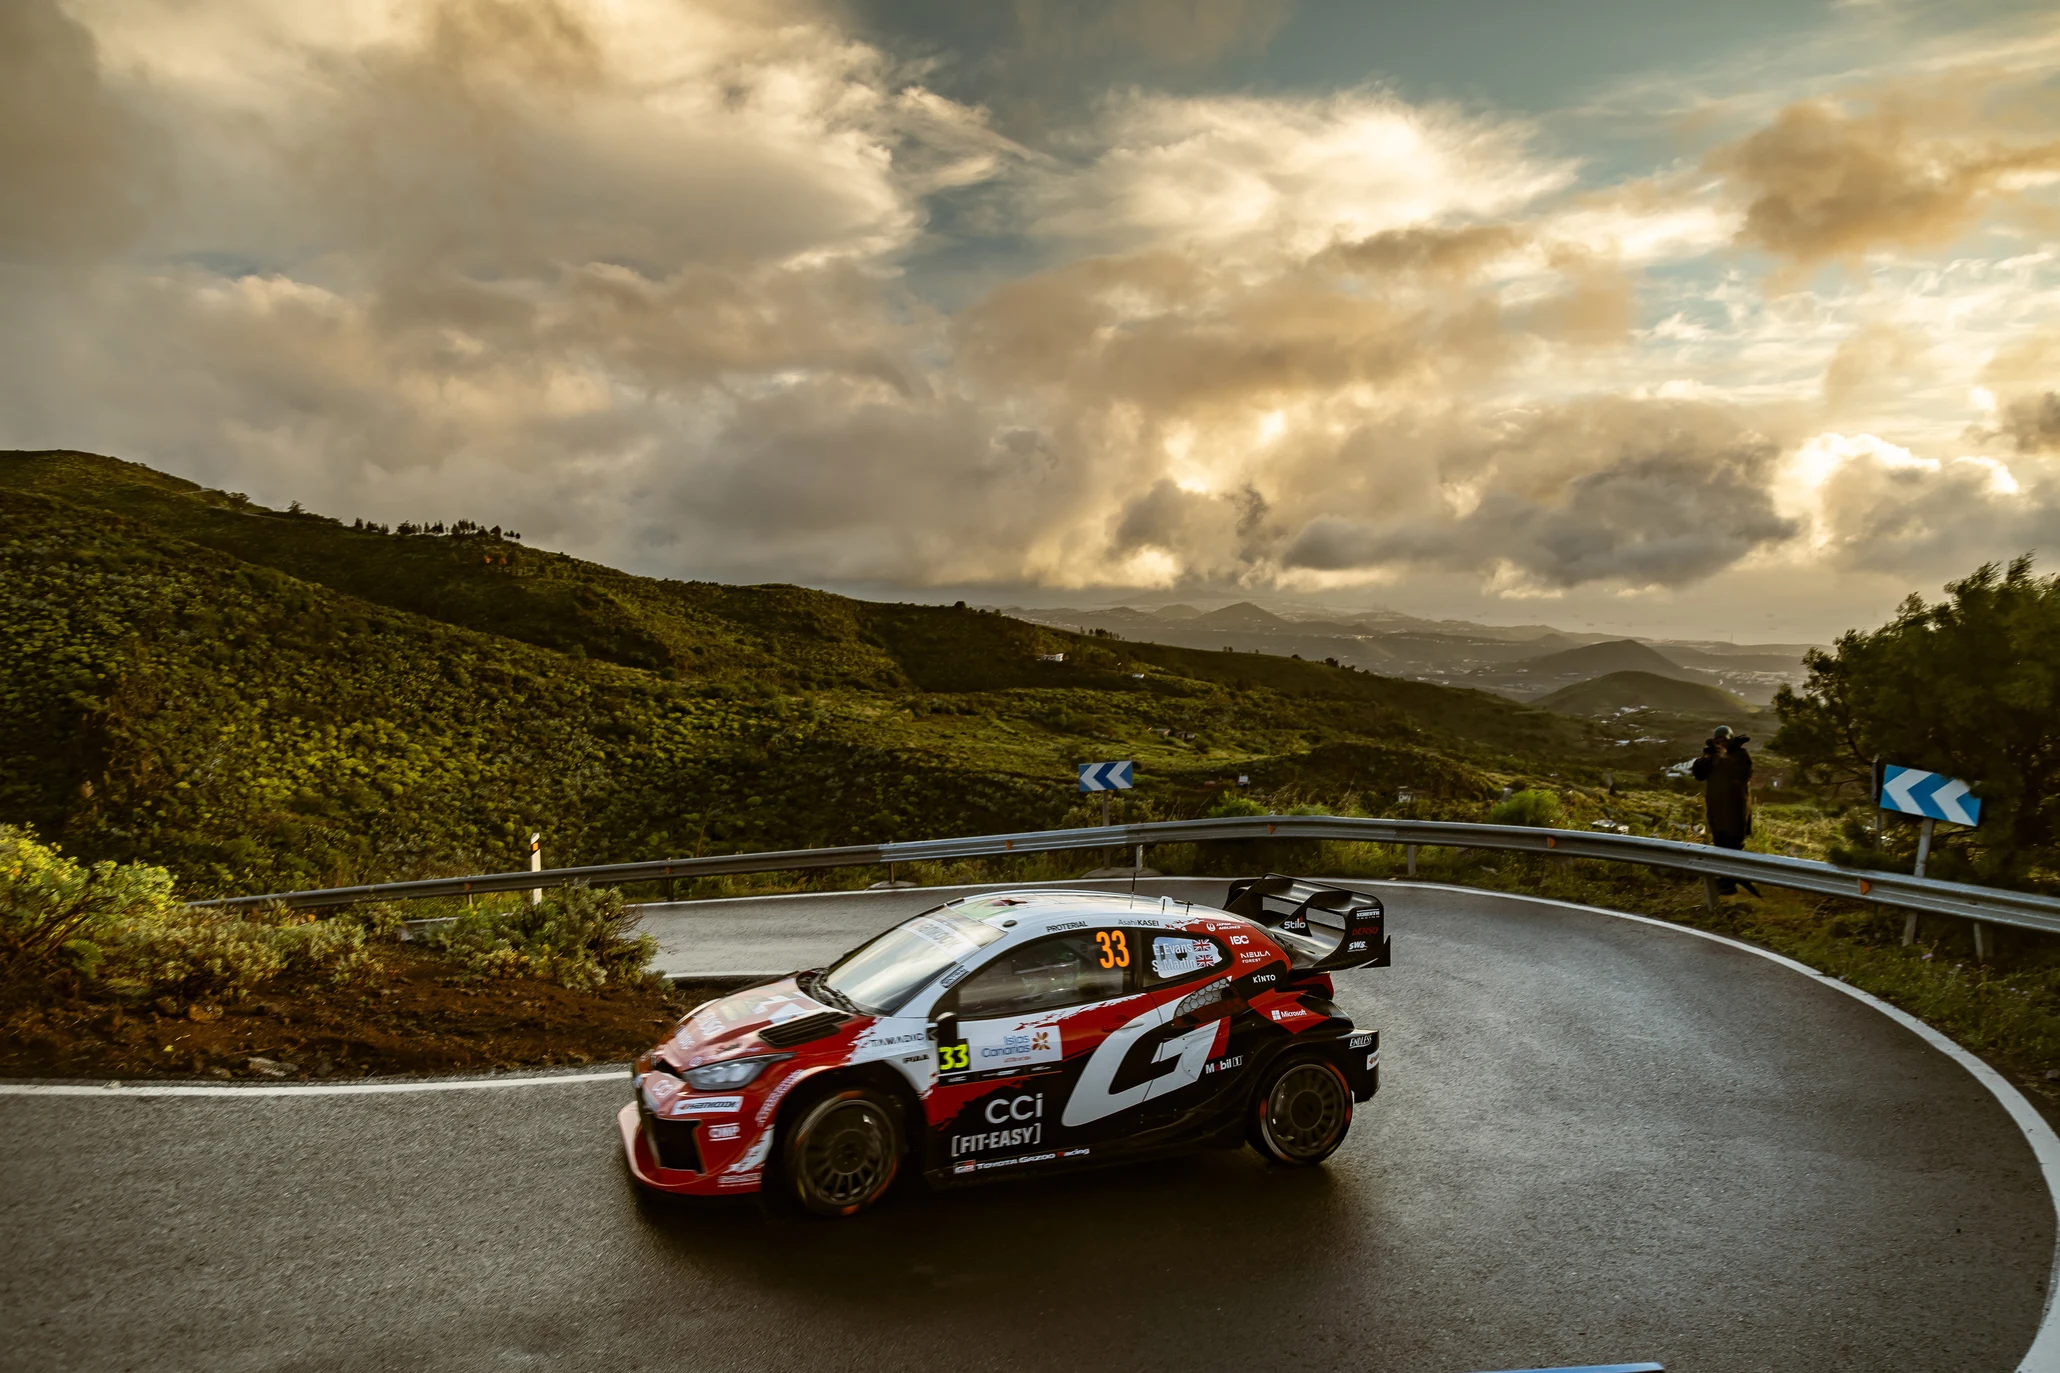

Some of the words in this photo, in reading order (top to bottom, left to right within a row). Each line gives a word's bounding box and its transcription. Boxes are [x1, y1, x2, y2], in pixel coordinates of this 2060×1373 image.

[1046, 920, 1089, 932] PROTERIAL
[1284, 918, 1306, 929] Stilo
[1352, 926, 1379, 936] DENSO
[1096, 930, 1130, 969] 33
[1280, 1009, 1307, 1018] Microsoft
[1004, 1035, 1030, 1046] Islas
[938, 1044, 969, 1070] 33
[1205, 1058, 1232, 1074] Mobil
